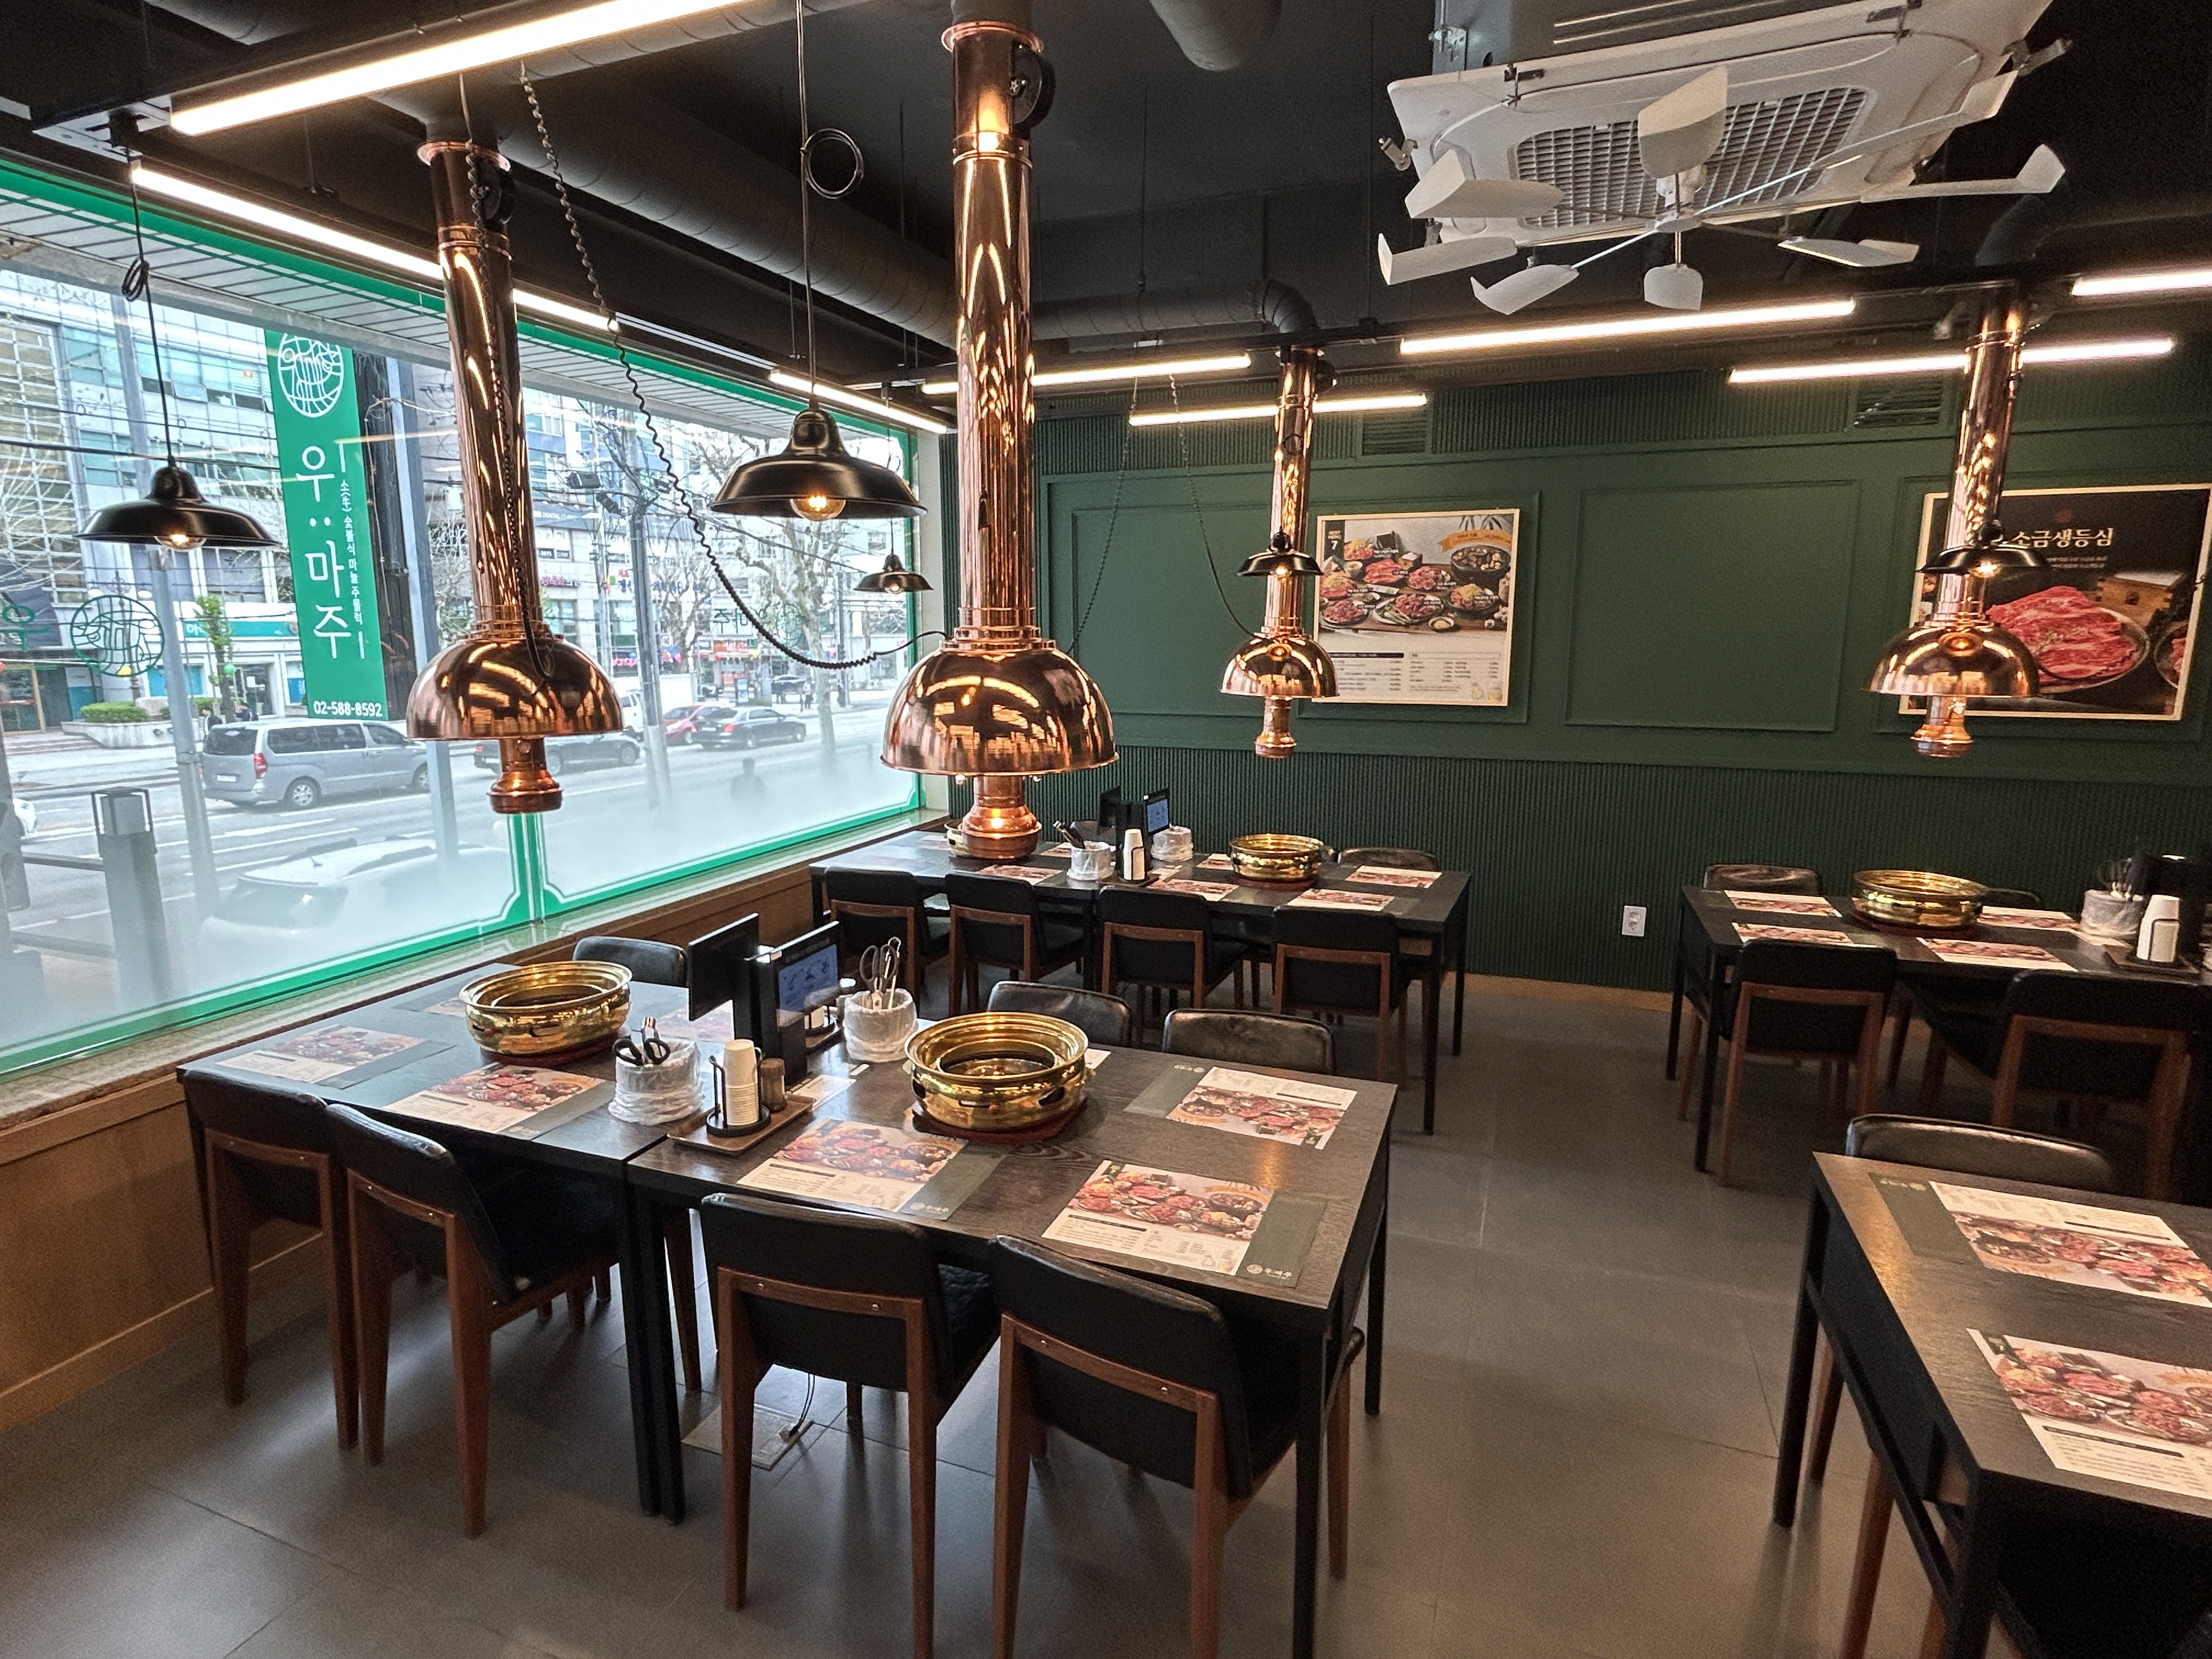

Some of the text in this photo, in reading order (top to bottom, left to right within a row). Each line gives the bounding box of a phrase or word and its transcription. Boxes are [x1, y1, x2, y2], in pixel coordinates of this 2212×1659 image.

[1331, 540, 1339, 550] 7
[2012, 527, 2114, 548] 소금생등심
[313, 700, 383, 718] 02-588-8592
